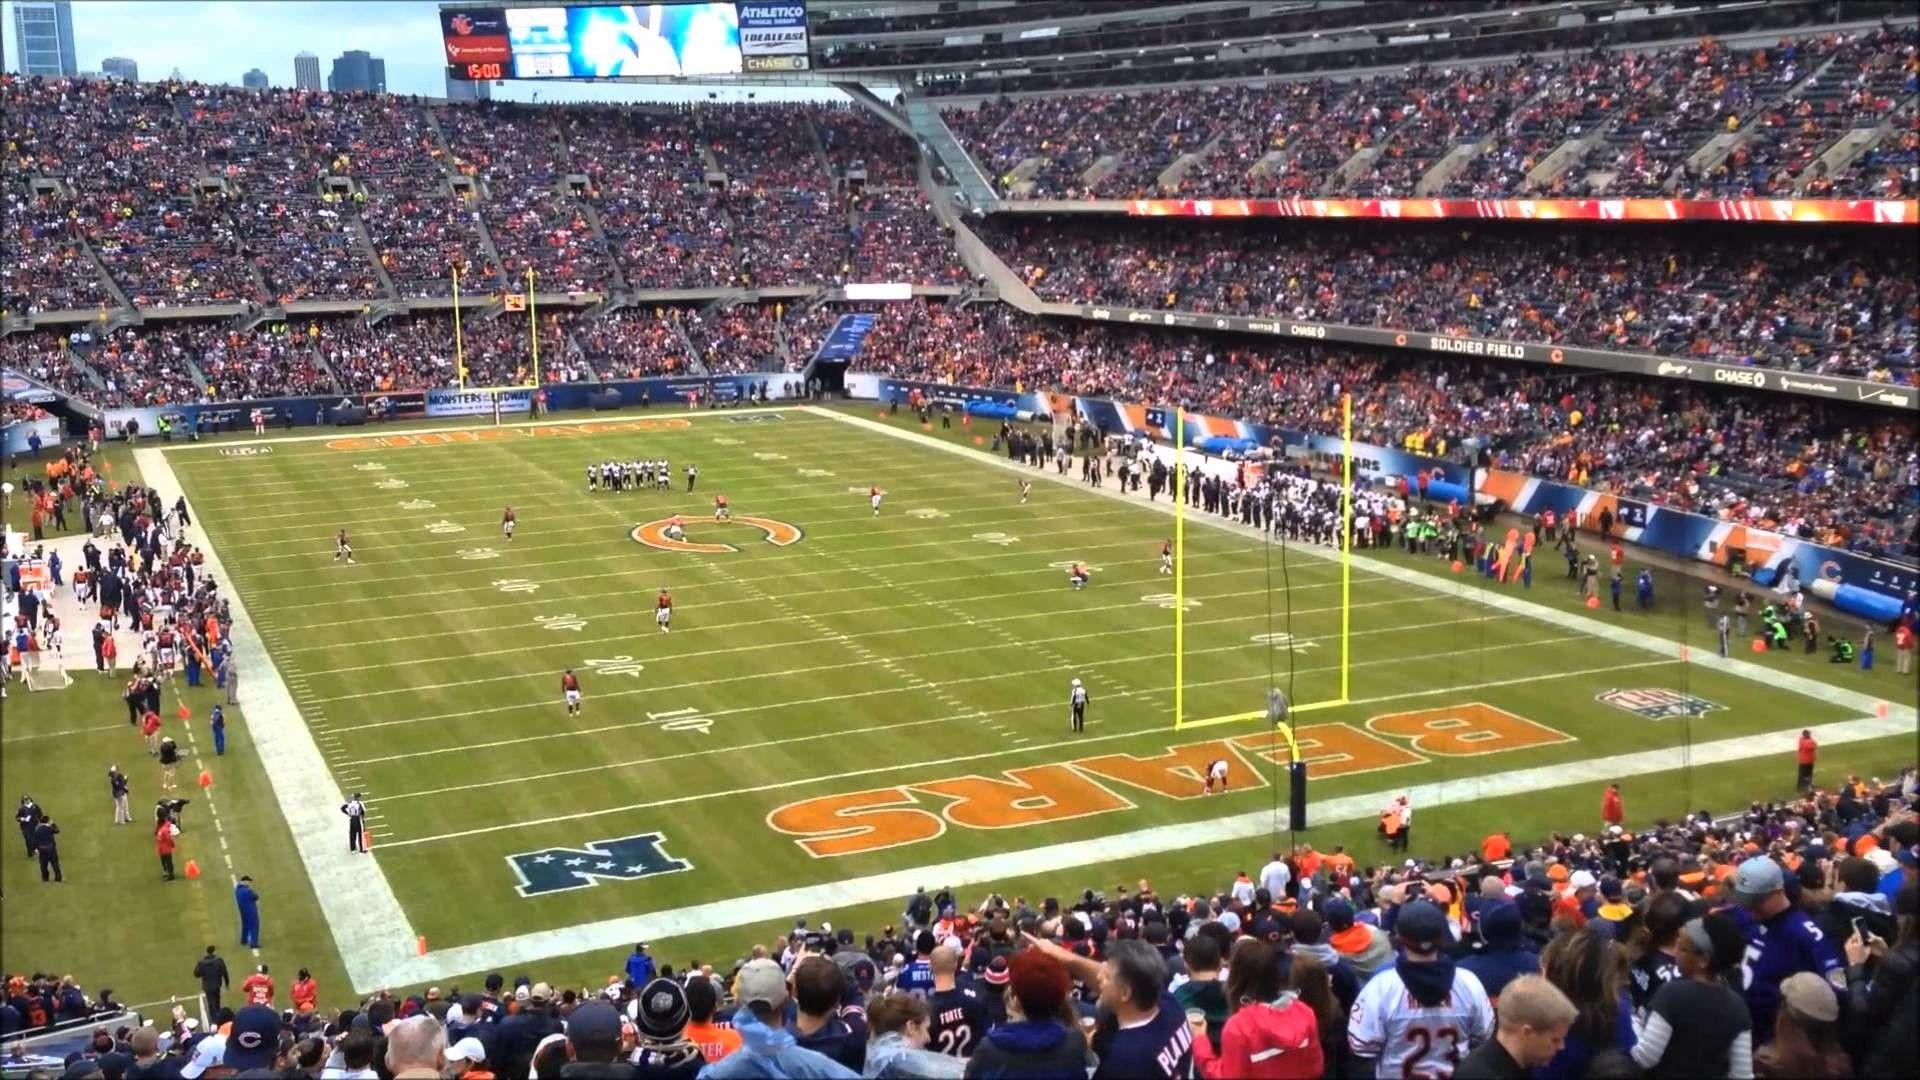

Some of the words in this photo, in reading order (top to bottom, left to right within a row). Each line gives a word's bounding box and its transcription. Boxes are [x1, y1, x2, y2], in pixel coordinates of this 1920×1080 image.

[741, 6, 804, 18] ATHLETICO
[745, 32, 804, 42] IDEALEASE
[468, 63, 501, 78] 15:00
[748, 59, 785, 69] CHASE
[1291, 325, 1317, 336] CHASE
[1430, 337, 1484, 354] SOLDIER
[1487, 343, 1525, 359] FIELD
[1715, 368, 1752, 385] CHASE
[429, 393, 480, 405] MONSTERS
[584, 655, 645, 677] 20
[645, 706, 714, 732] 10
[766, 703, 1577, 858] BEARS
[1803, 920, 1824, 941] 5
[939, 1008, 963, 1025] FORTE
[939, 1024, 972, 1059] 22
[1402, 1026, 1459, 1080] 23
